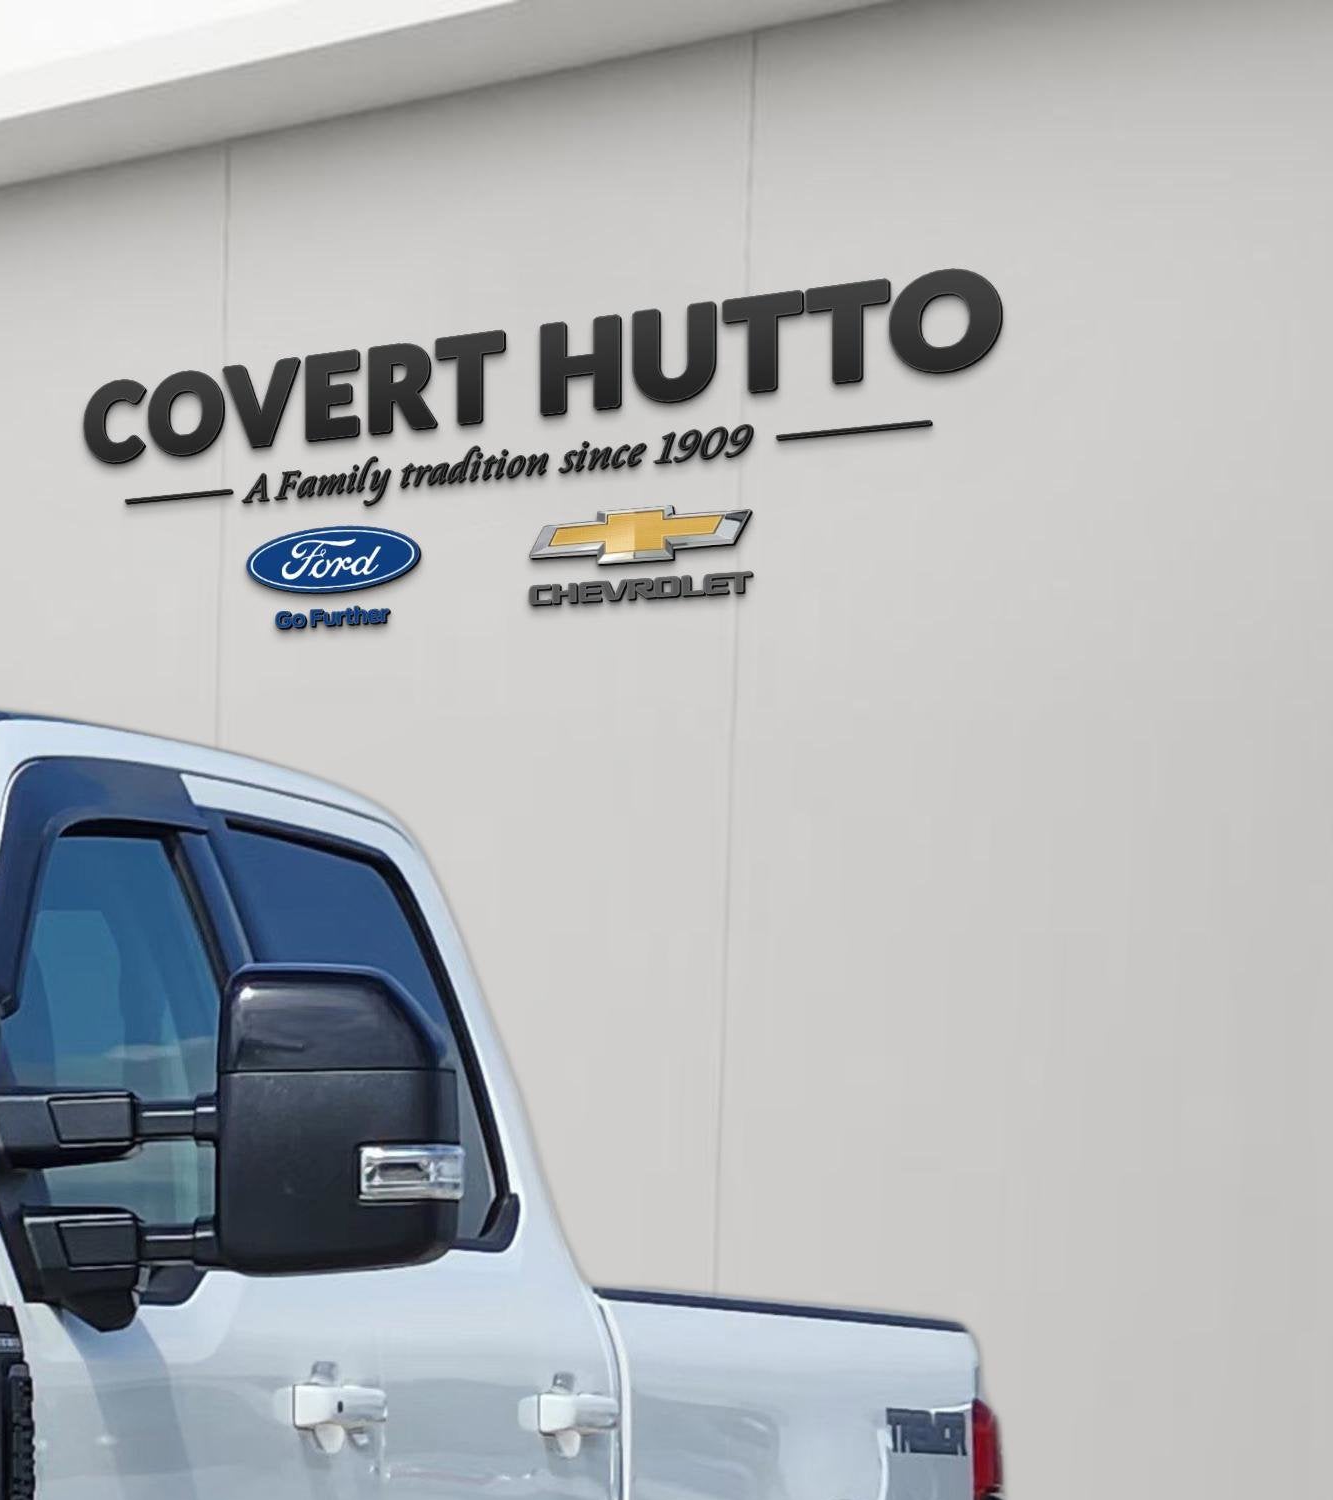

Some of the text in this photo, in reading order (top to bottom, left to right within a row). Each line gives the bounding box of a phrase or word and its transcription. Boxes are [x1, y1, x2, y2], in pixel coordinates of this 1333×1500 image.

[82, 267, 1004, 463] COVERT HUTTO
[242, 424, 754, 507] A Family tradition since 1909
[281, 538, 381, 580] Ford
[529, 571, 753, 606] CHEVROLET
[275, 606, 390, 629] Go Further
